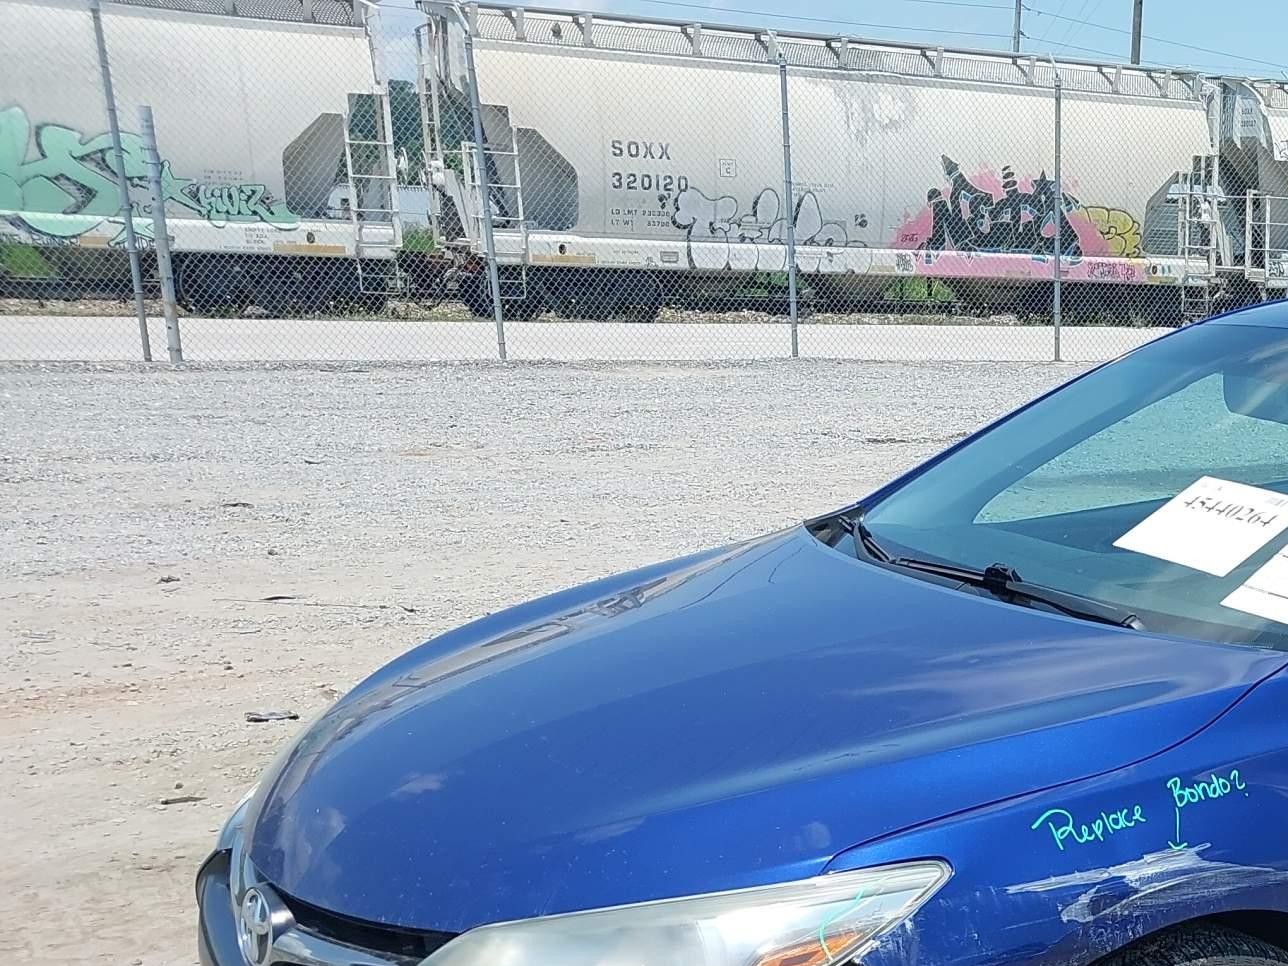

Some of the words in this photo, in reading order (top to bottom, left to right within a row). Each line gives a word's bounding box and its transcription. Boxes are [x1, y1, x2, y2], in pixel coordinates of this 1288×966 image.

[611, 139, 671, 160] SOXX
[611, 172, 689, 193] 320120
[1183, 495, 1279, 528] 45440264
[1031, 804, 1147, 851] Replace
